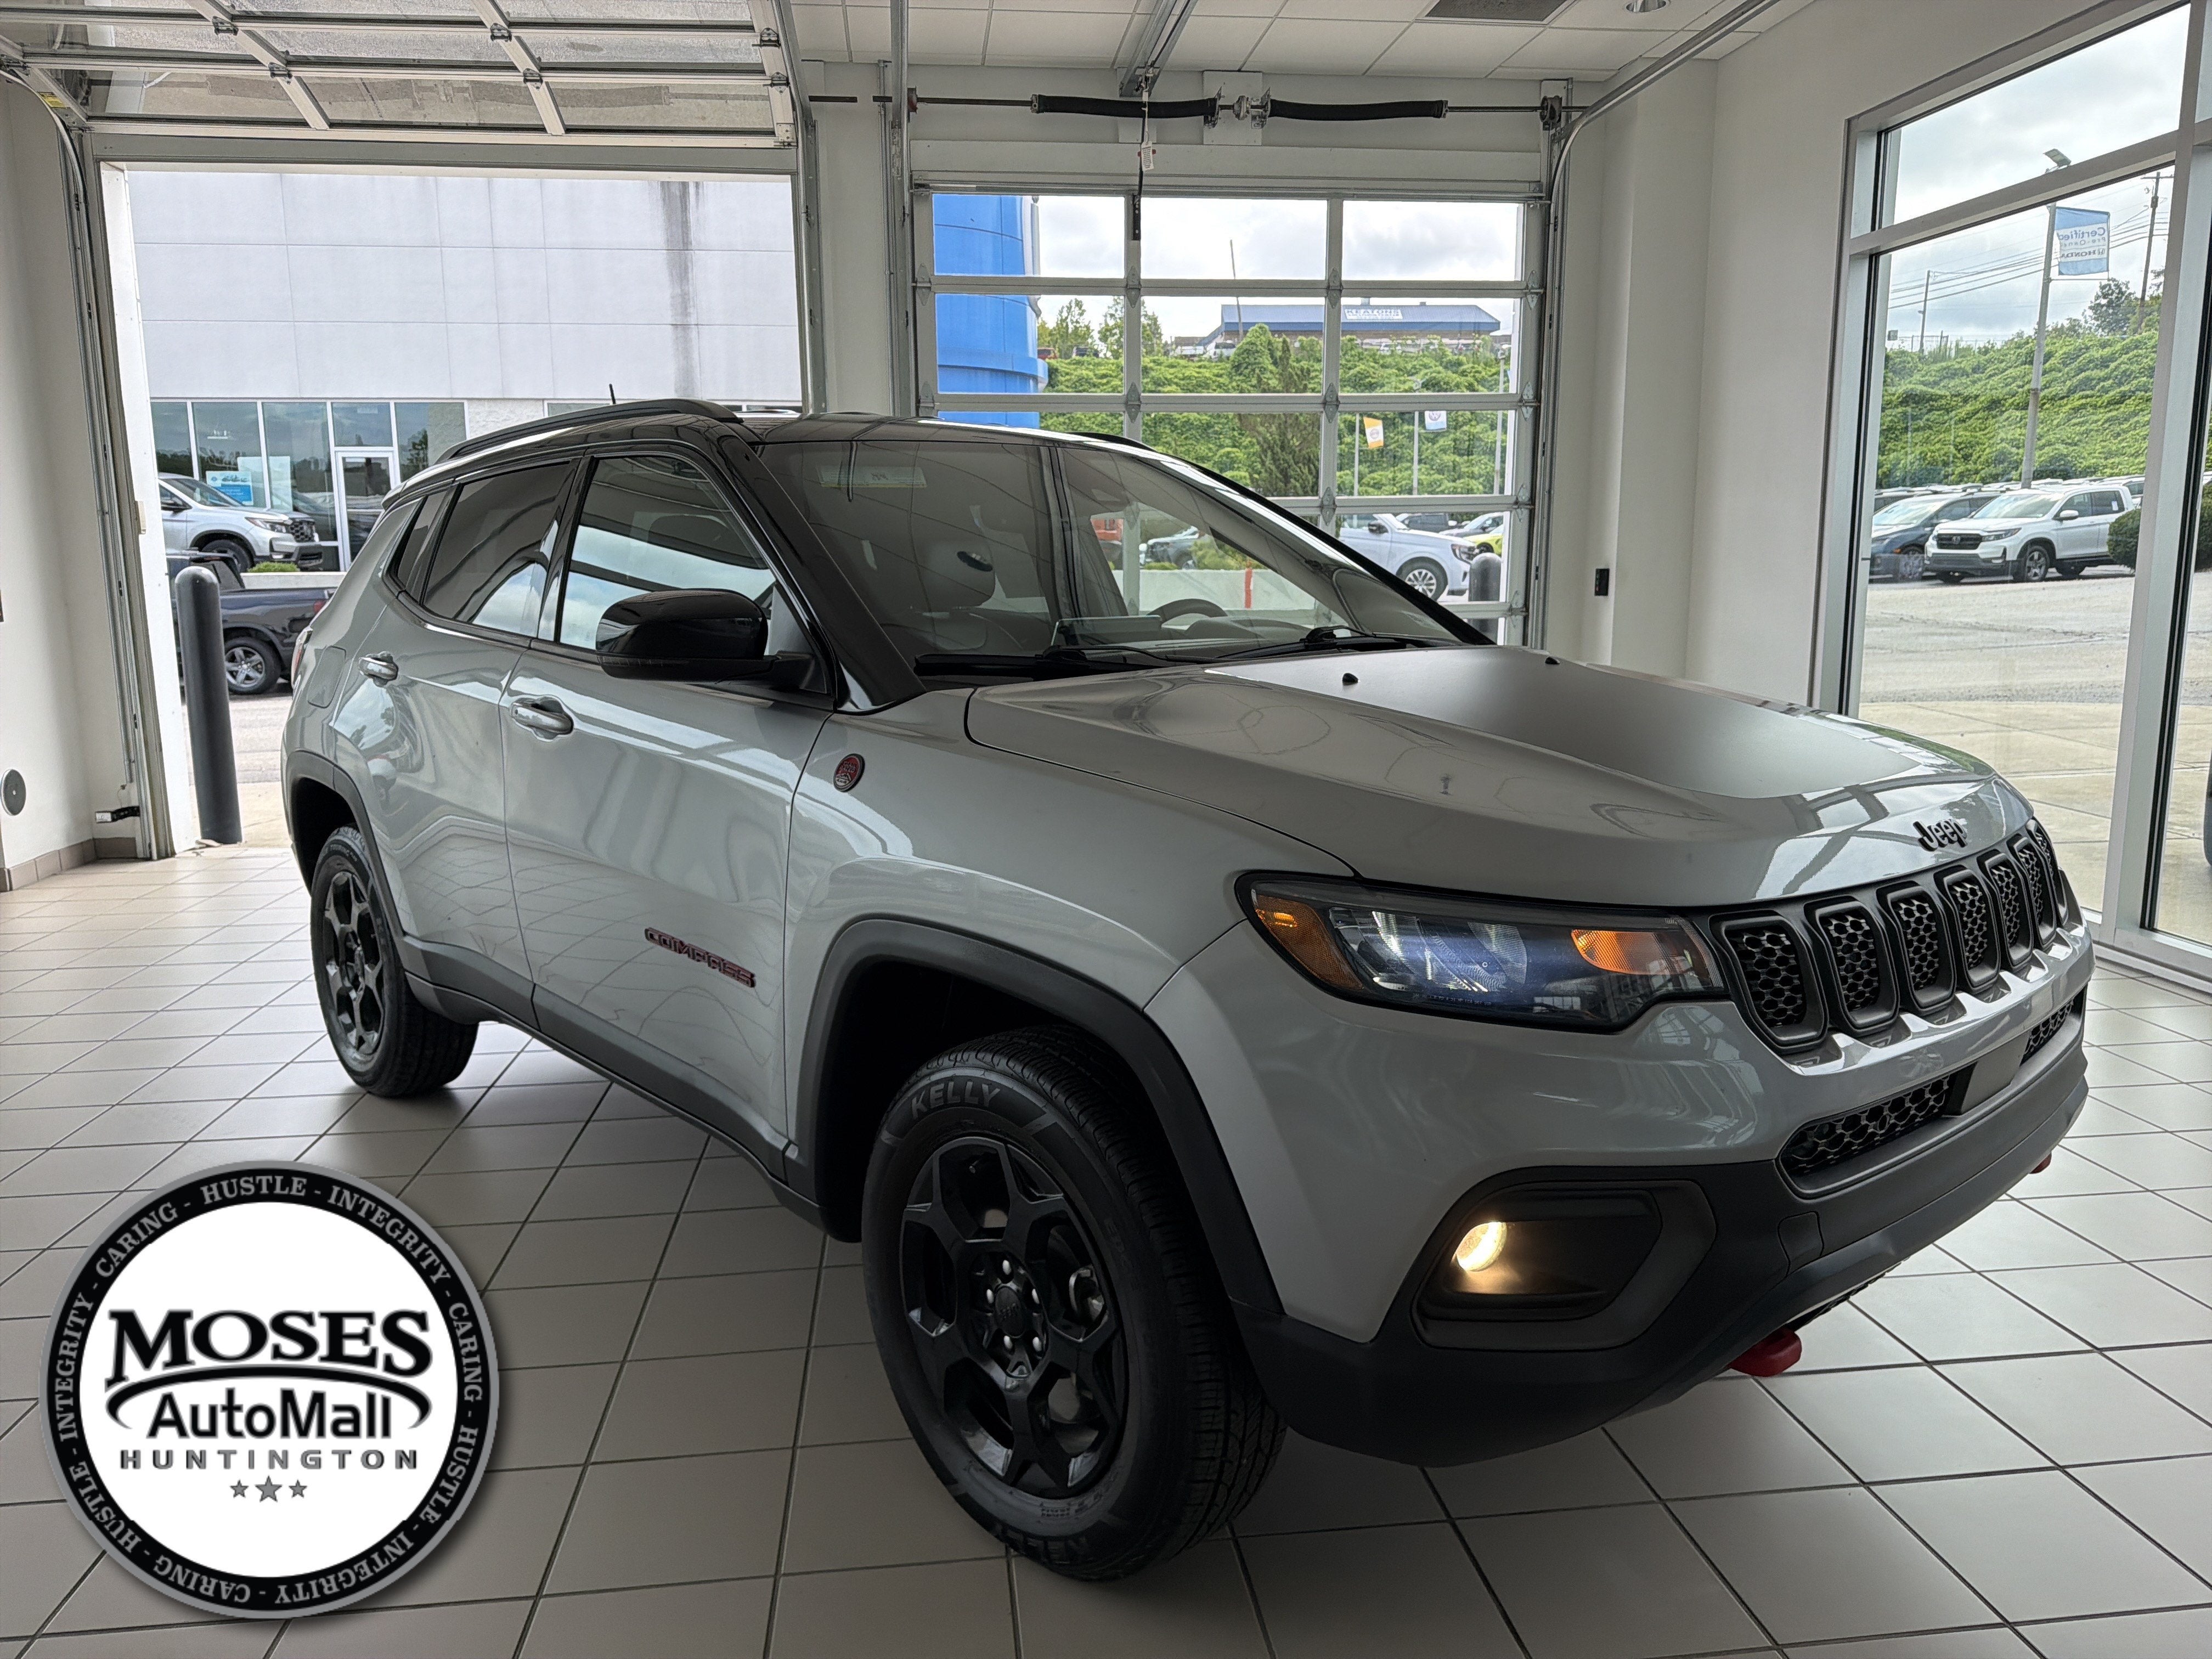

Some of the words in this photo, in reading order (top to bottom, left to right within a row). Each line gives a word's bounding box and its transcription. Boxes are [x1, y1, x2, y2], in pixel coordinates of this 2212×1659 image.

[1913, 819, 1967, 851] Jeep
[645, 927, 755, 988] COMPASS
[912, 1080, 1000, 1120] KELLY
